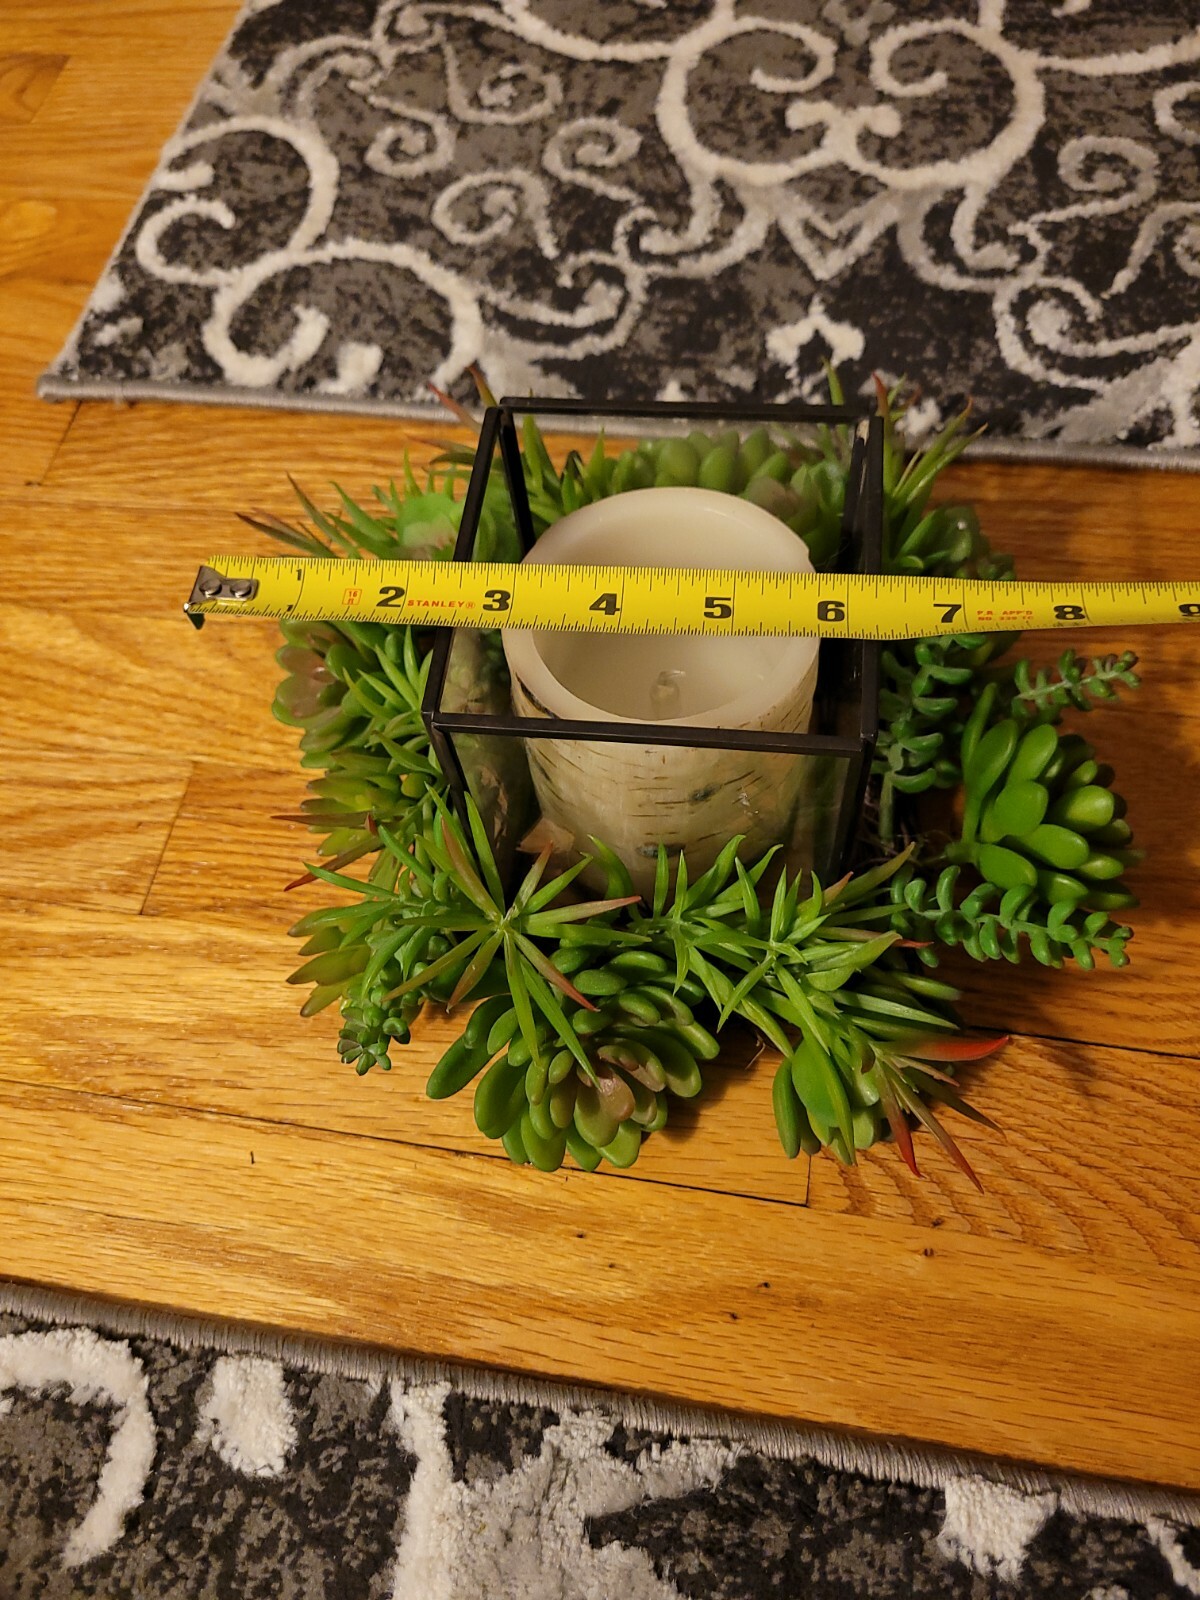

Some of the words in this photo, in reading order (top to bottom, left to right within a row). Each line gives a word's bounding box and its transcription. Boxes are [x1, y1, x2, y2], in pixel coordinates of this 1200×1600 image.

[296, 568, 302, 581] 1
[376, 586, 405, 607] 2
[482, 590, 511, 611] 3
[589, 593, 620, 615] 4
[703, 597, 732, 618] 5
[817, 601, 845, 621] 6
[933, 604, 962, 623] 7
[1053, 605, 1085, 620] 8
